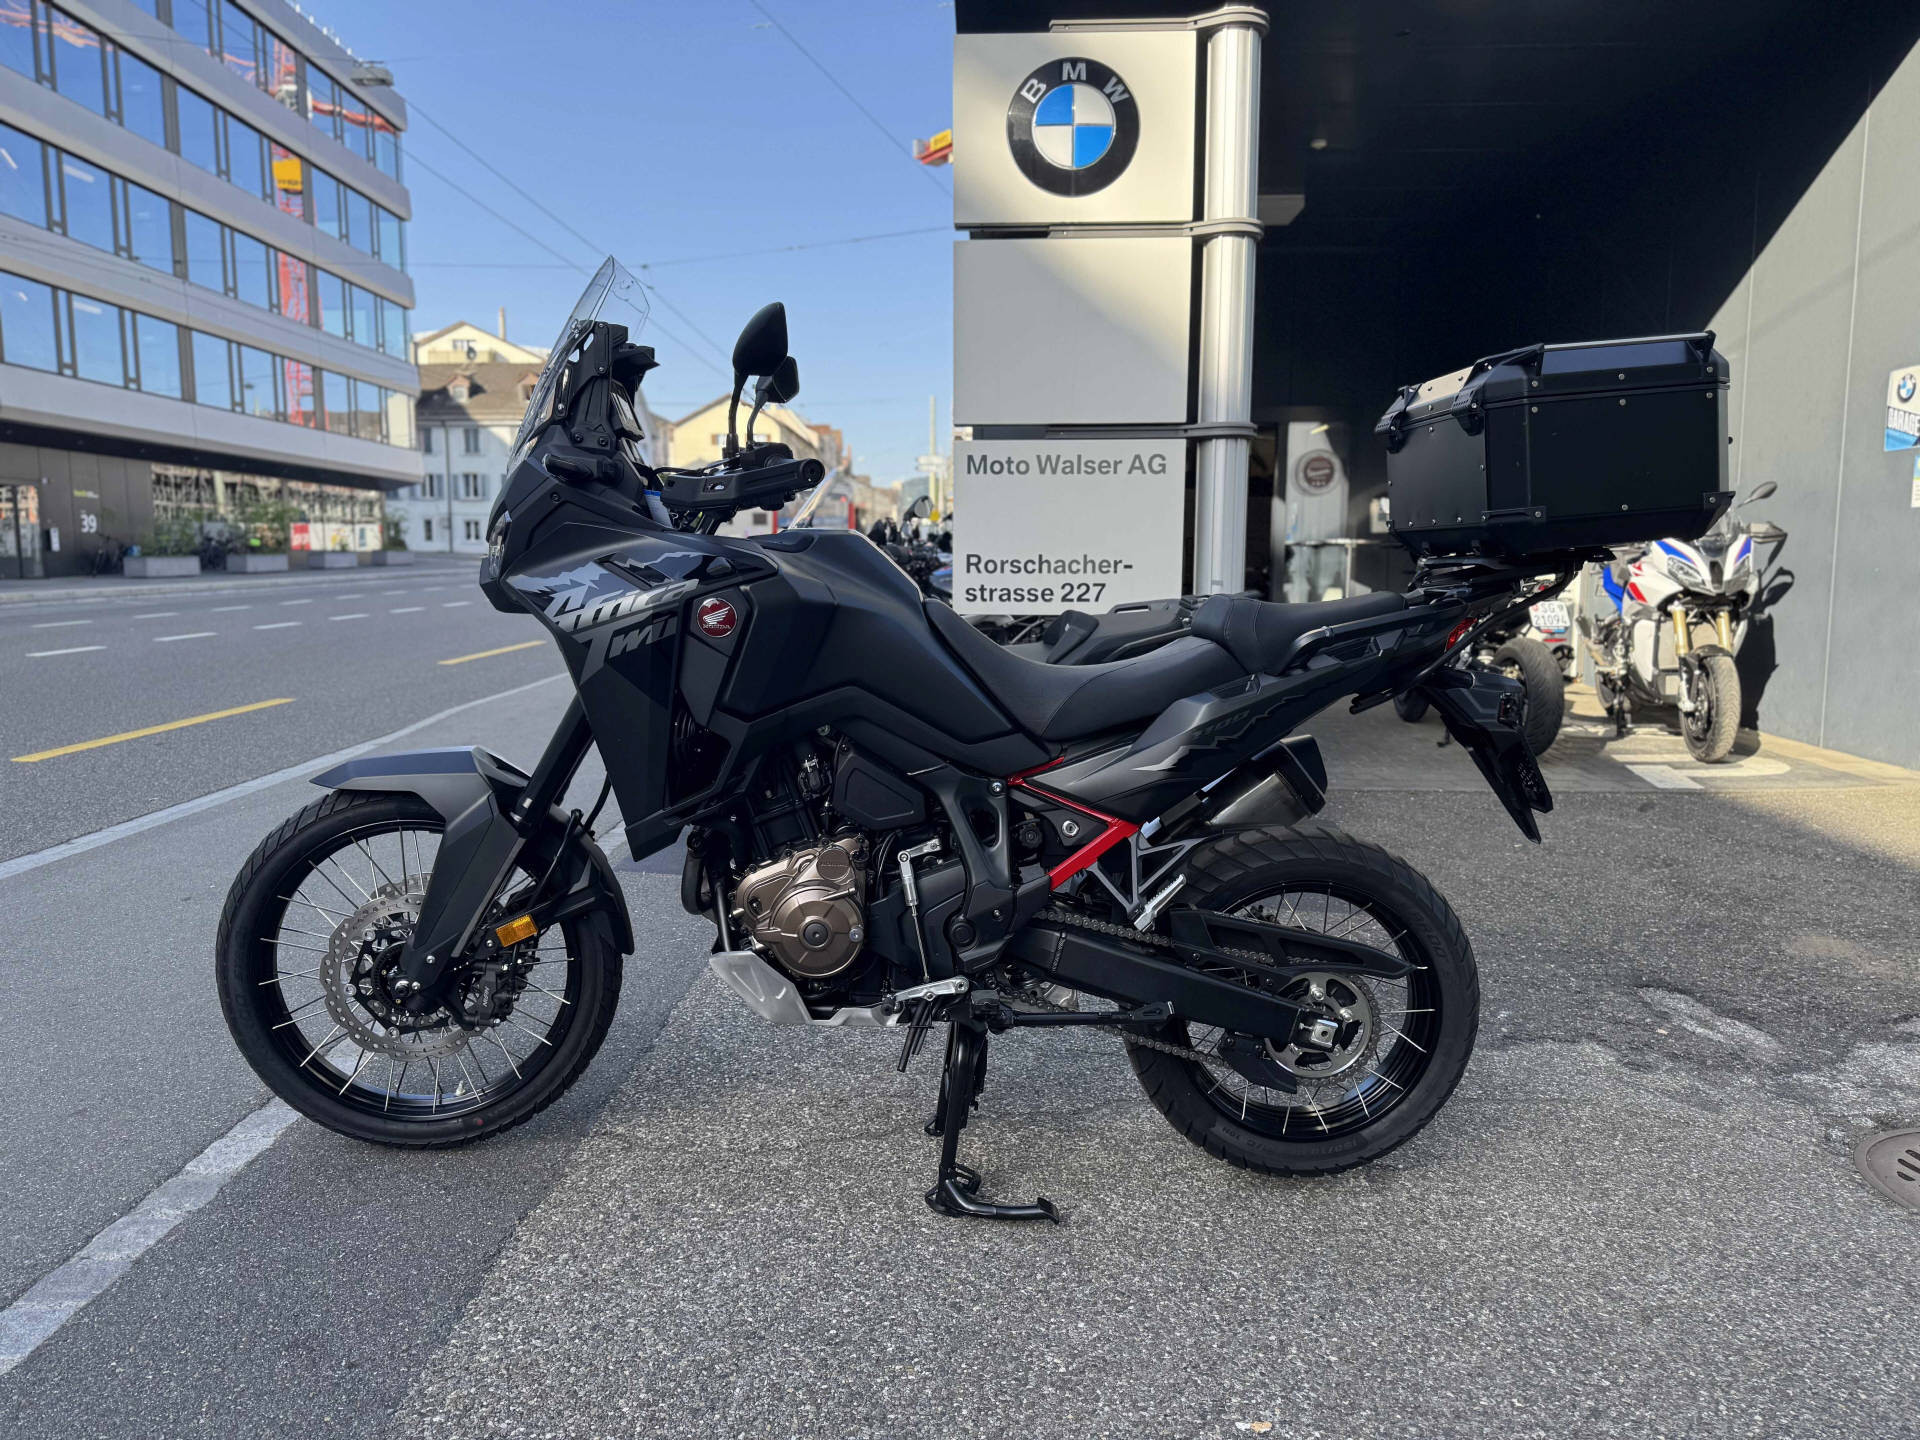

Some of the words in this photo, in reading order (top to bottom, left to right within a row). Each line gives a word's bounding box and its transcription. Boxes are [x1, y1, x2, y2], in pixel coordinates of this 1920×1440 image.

[1020, 62, 1130, 104] BMW
[966, 454, 1030, 475] Moto
[1036, 454, 1123, 475] Walser
[1127, 453, 1167, 475] AG
[80, 514, 97, 533] 39
[965, 553, 1133, 575] Rorschacher-
[964, 584, 1054, 603] strasse
[1060, 583, 1107, 603] 227
[1540, 602, 1556, 613] SG
[1533, 614, 1568, 626] 21094
